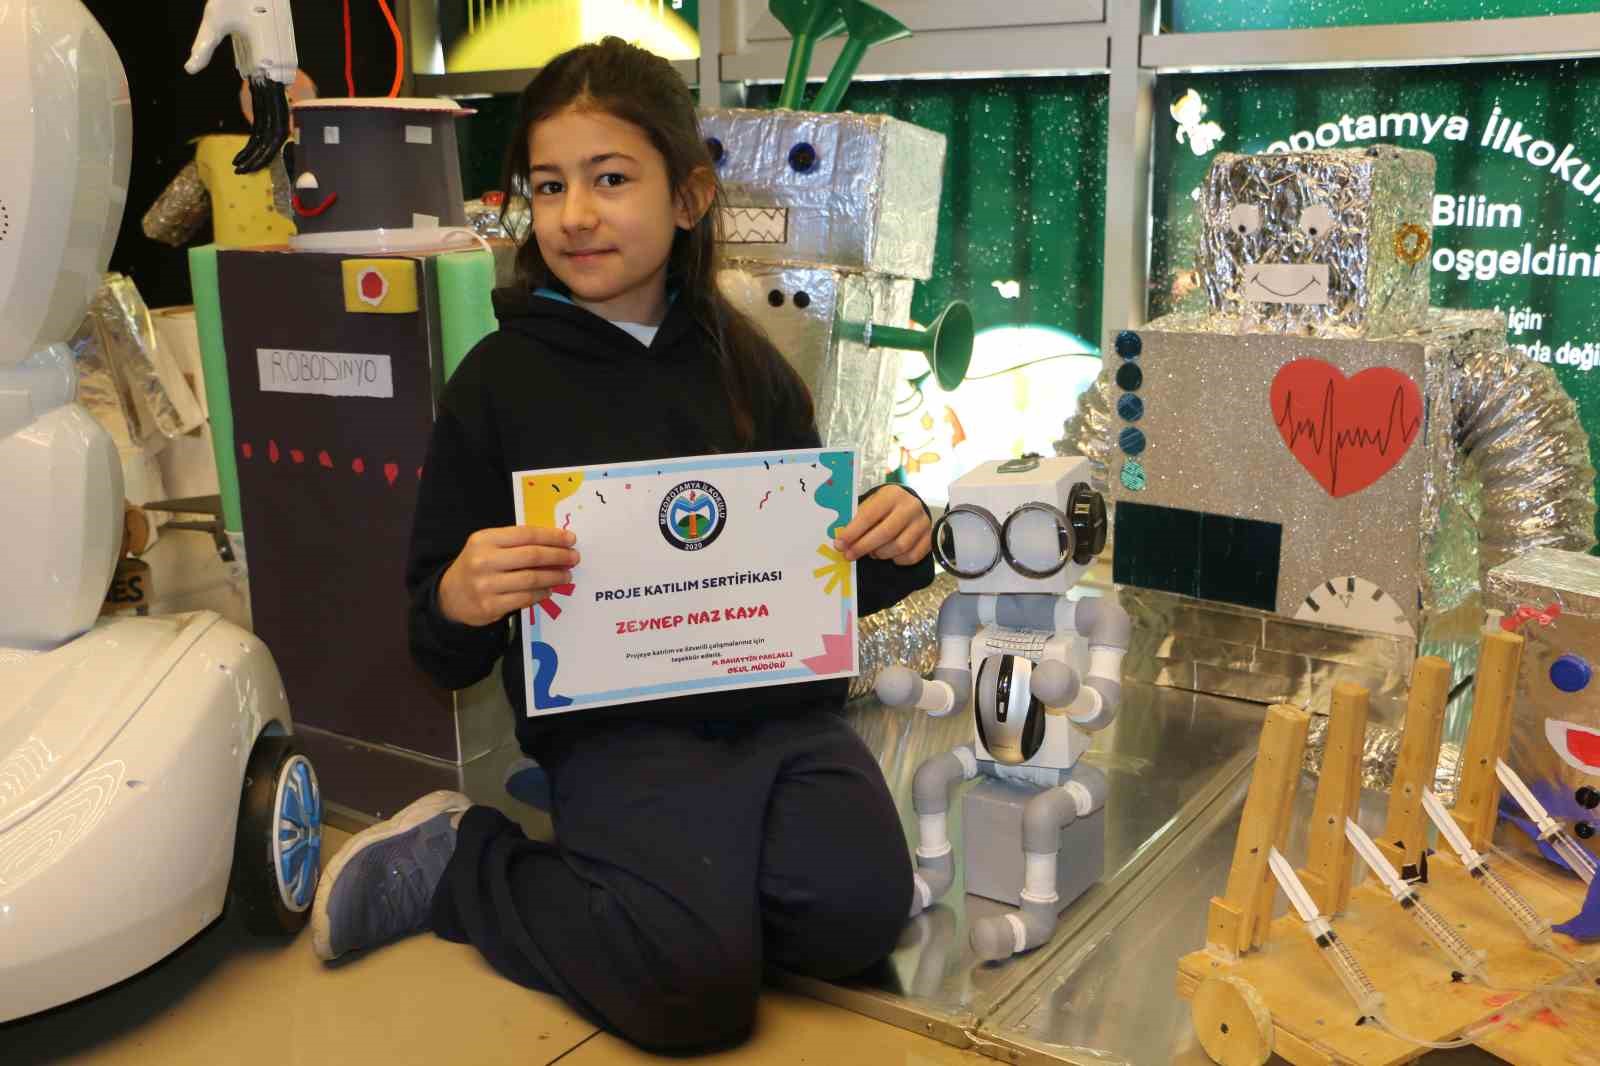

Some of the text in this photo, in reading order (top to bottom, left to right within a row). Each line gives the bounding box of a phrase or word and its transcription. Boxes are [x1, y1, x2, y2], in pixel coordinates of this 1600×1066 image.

[1256, 105, 1600, 203] opotamya İlkoku
[1431, 193, 1522, 228] Bilim
[1431, 242, 1600, 281] oşgeldini
[1508, 305, 1543, 336] için
[1555, 341, 1600, 371] deği
[684, 542, 703, 551] 2020
[595, 570, 782, 602] PROJE KATILIM SERTİFİKASI
[615, 604, 769, 635] ZEYNEP NAZ KAYA
